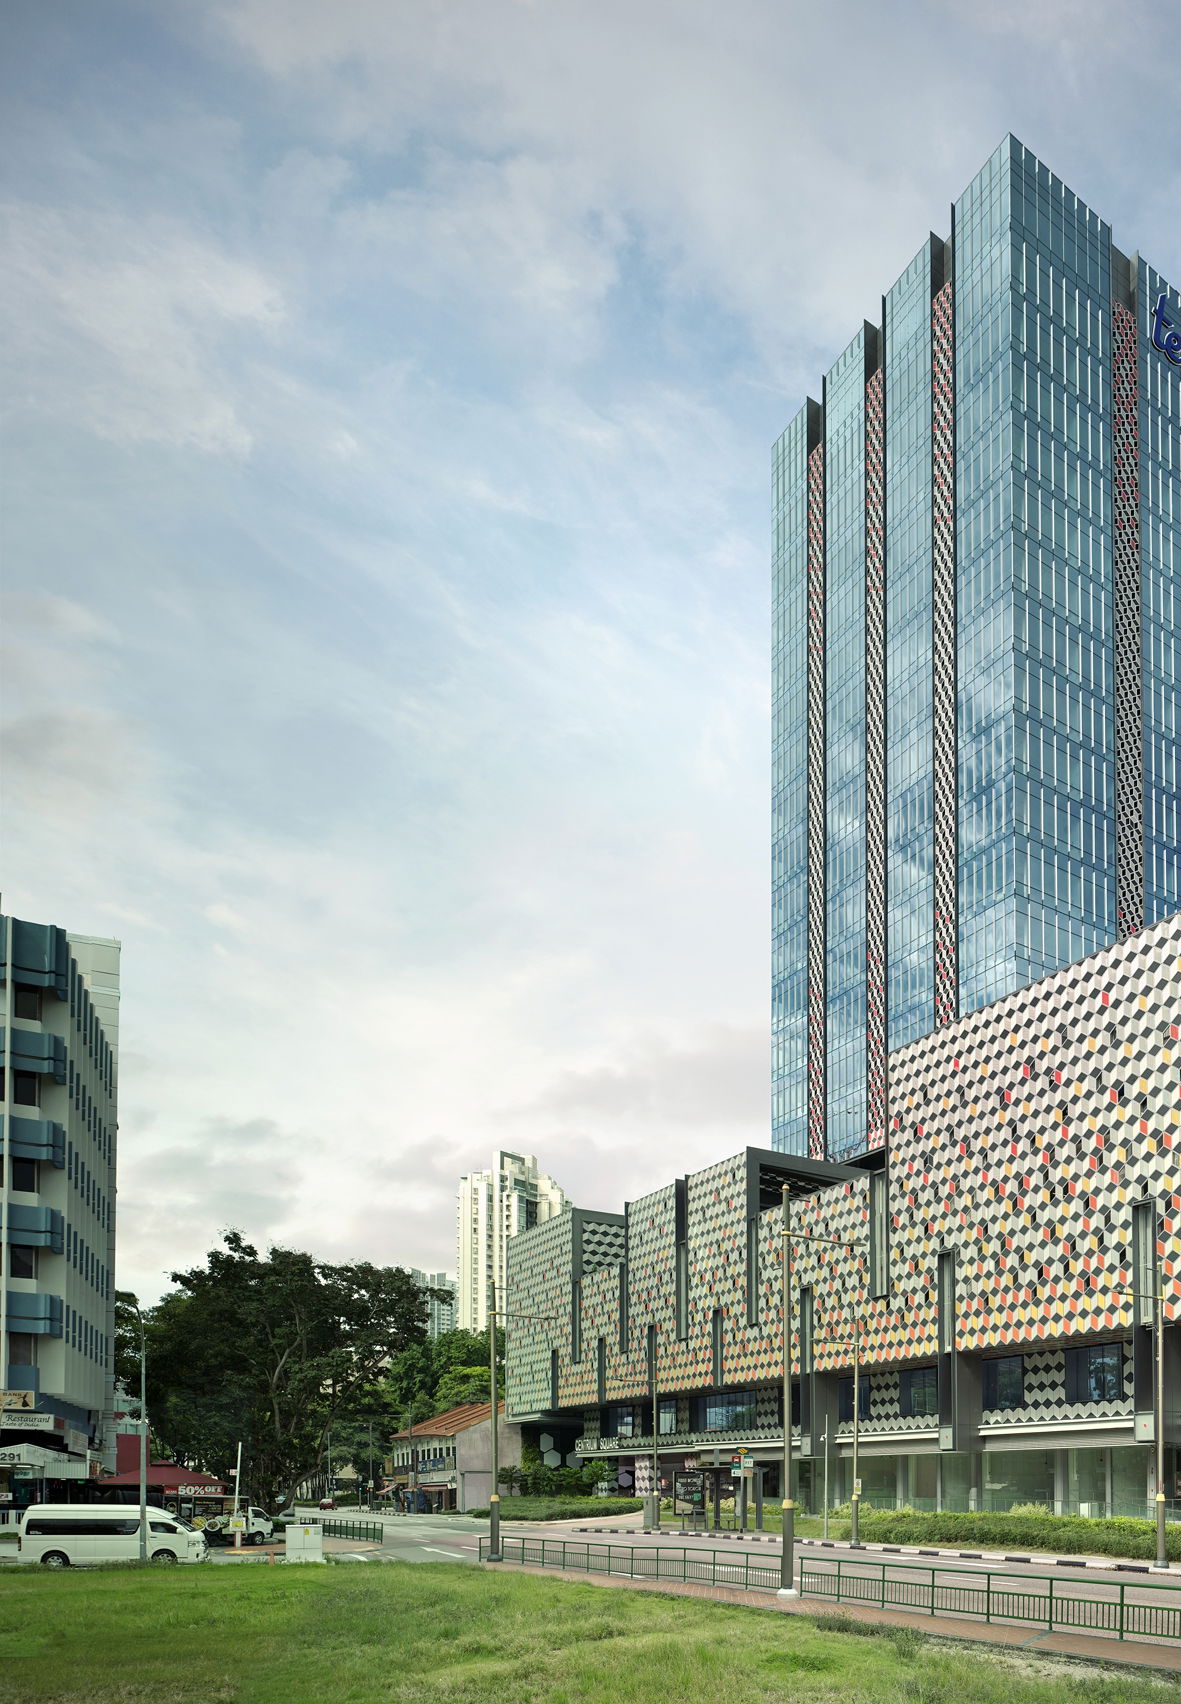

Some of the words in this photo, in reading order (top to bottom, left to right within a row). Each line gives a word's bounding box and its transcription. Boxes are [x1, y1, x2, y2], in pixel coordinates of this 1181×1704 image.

[5, 1414, 50, 1423] Restaurant
[575, 1439, 597, 1451] CENTRIUM
[600, 1437, 619, 1450] SQUARE
[0, 1453, 21, 1462] 291
[178, 1486, 204, 1495] 50%
